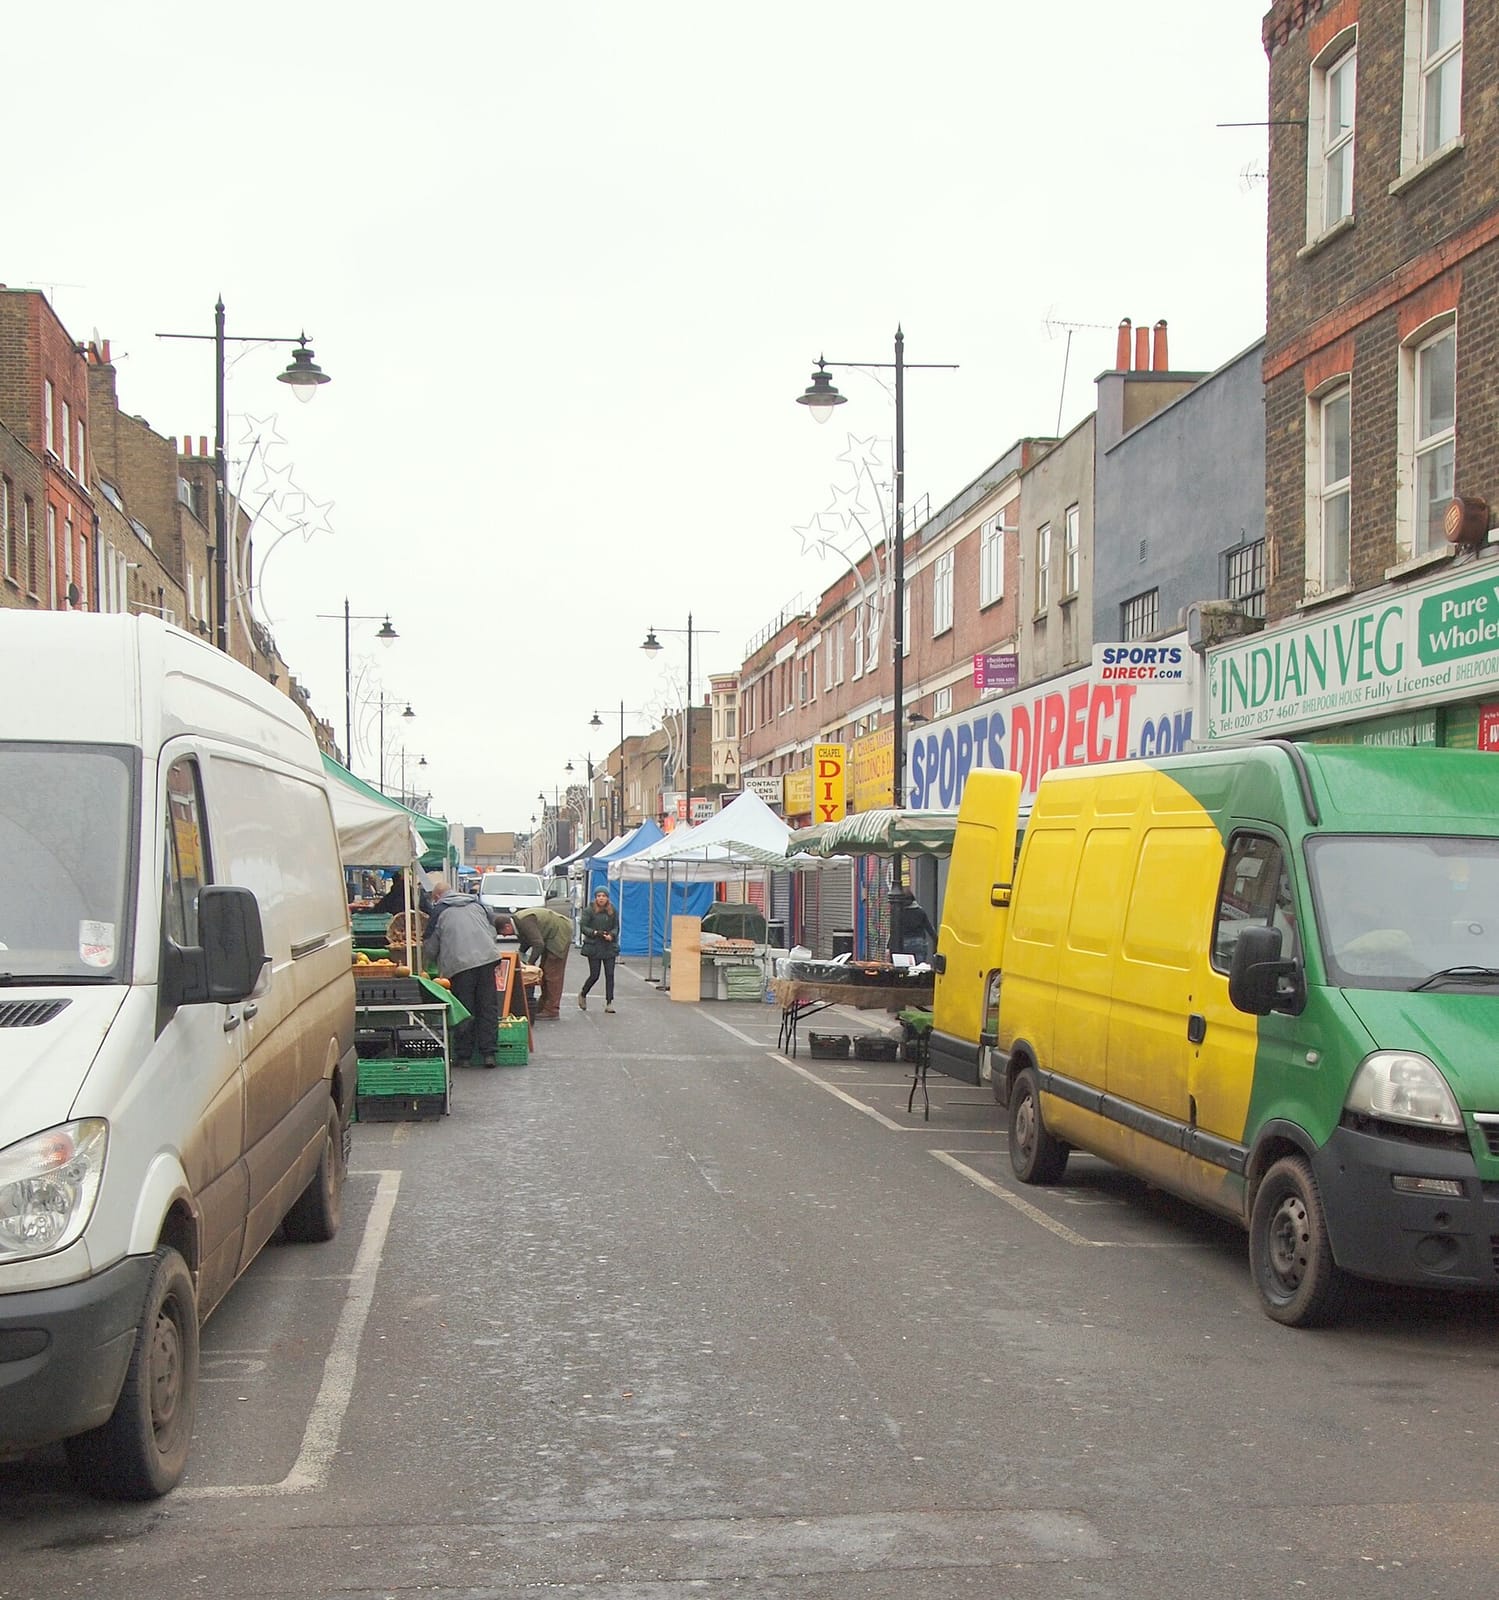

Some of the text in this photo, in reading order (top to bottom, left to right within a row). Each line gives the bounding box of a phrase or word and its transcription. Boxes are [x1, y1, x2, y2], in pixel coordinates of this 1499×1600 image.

[1441, 596, 1488, 622] Pure
[1102, 647, 1182, 664] SPORTS
[1102, 667, 1182, 679] DIRECT.COM
[1221, 605, 1404, 714] INDIAN VEG
[1220, 718, 1233, 732] Tel:
[1234, 713, 1256, 728] 0207
[1257, 709, 1274, 723] 837
[1276, 703, 1299, 719] 4607
[1365, 681, 1392, 701] Fully
[1396, 666, 1451, 694] Licensed
[910, 710, 1006, 811] SPORTS
